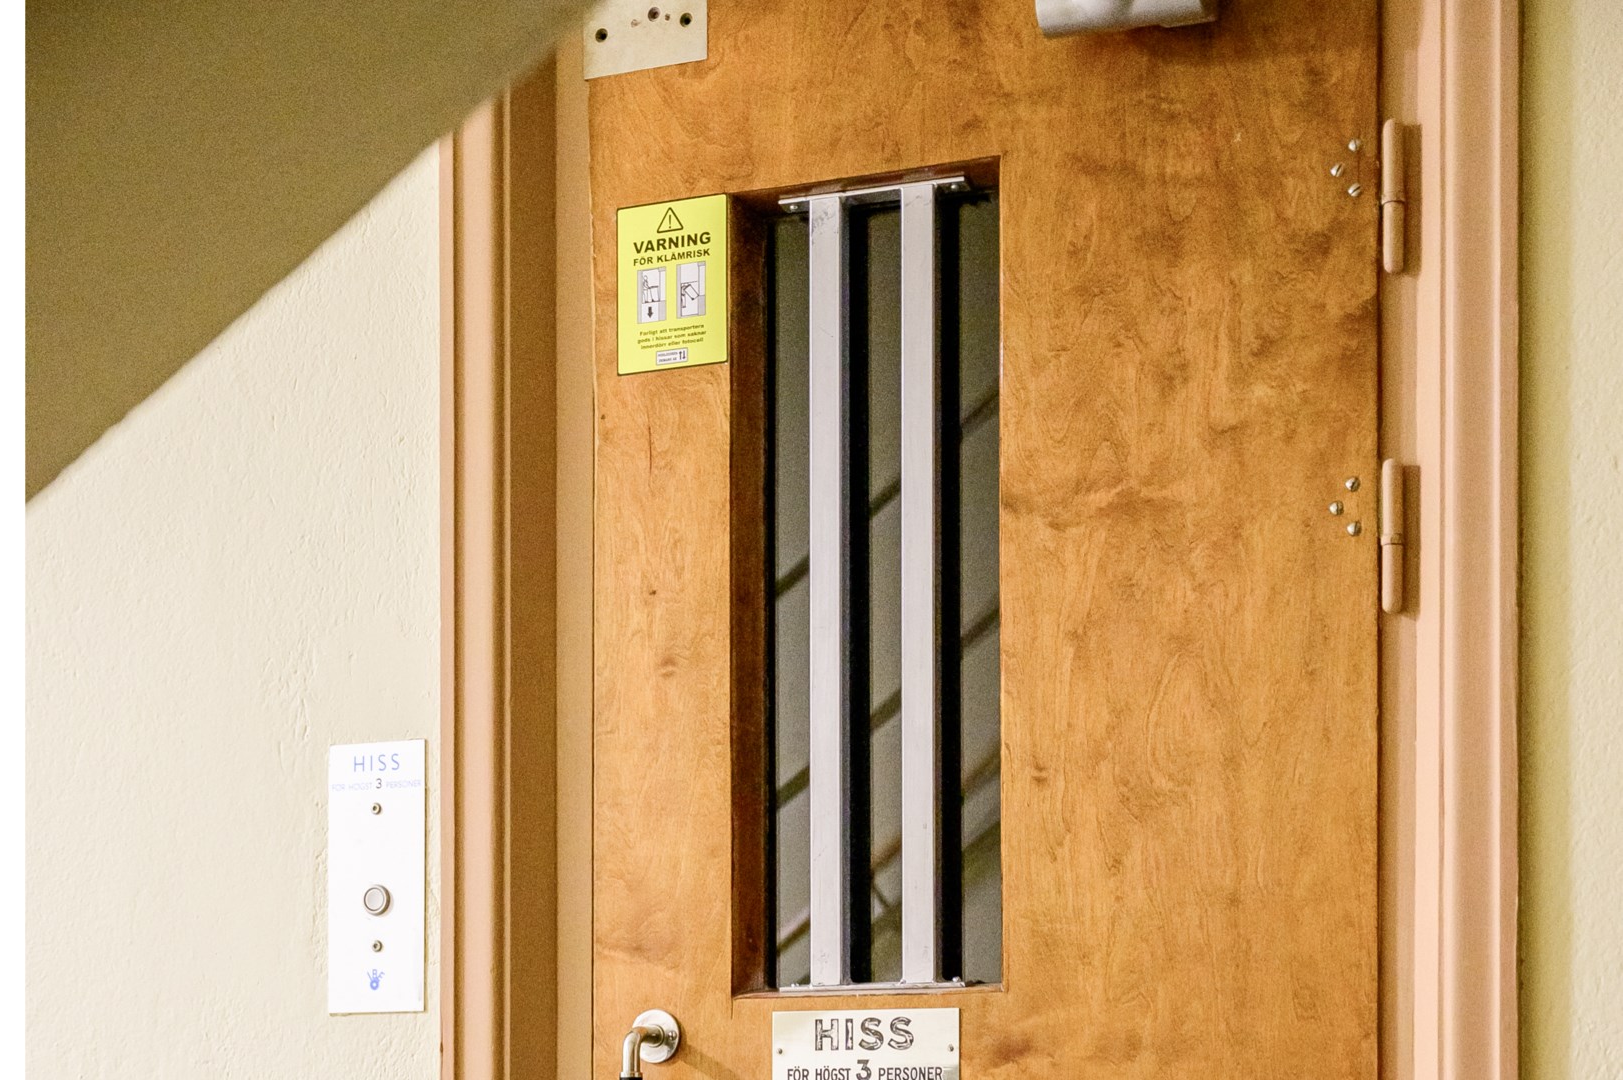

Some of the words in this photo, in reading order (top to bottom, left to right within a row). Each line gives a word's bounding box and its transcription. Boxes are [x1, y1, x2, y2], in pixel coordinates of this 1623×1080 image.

[633, 231, 711, 254] VARNING
[633, 256, 654, 267] FÖR
[657, 248, 711, 263] KLÄMRISK
[668, 323, 705, 333] transportera
[353, 753, 400, 772] HISS
[375, 777, 382, 789] 3
[814, 1016, 914, 1051] HISS
